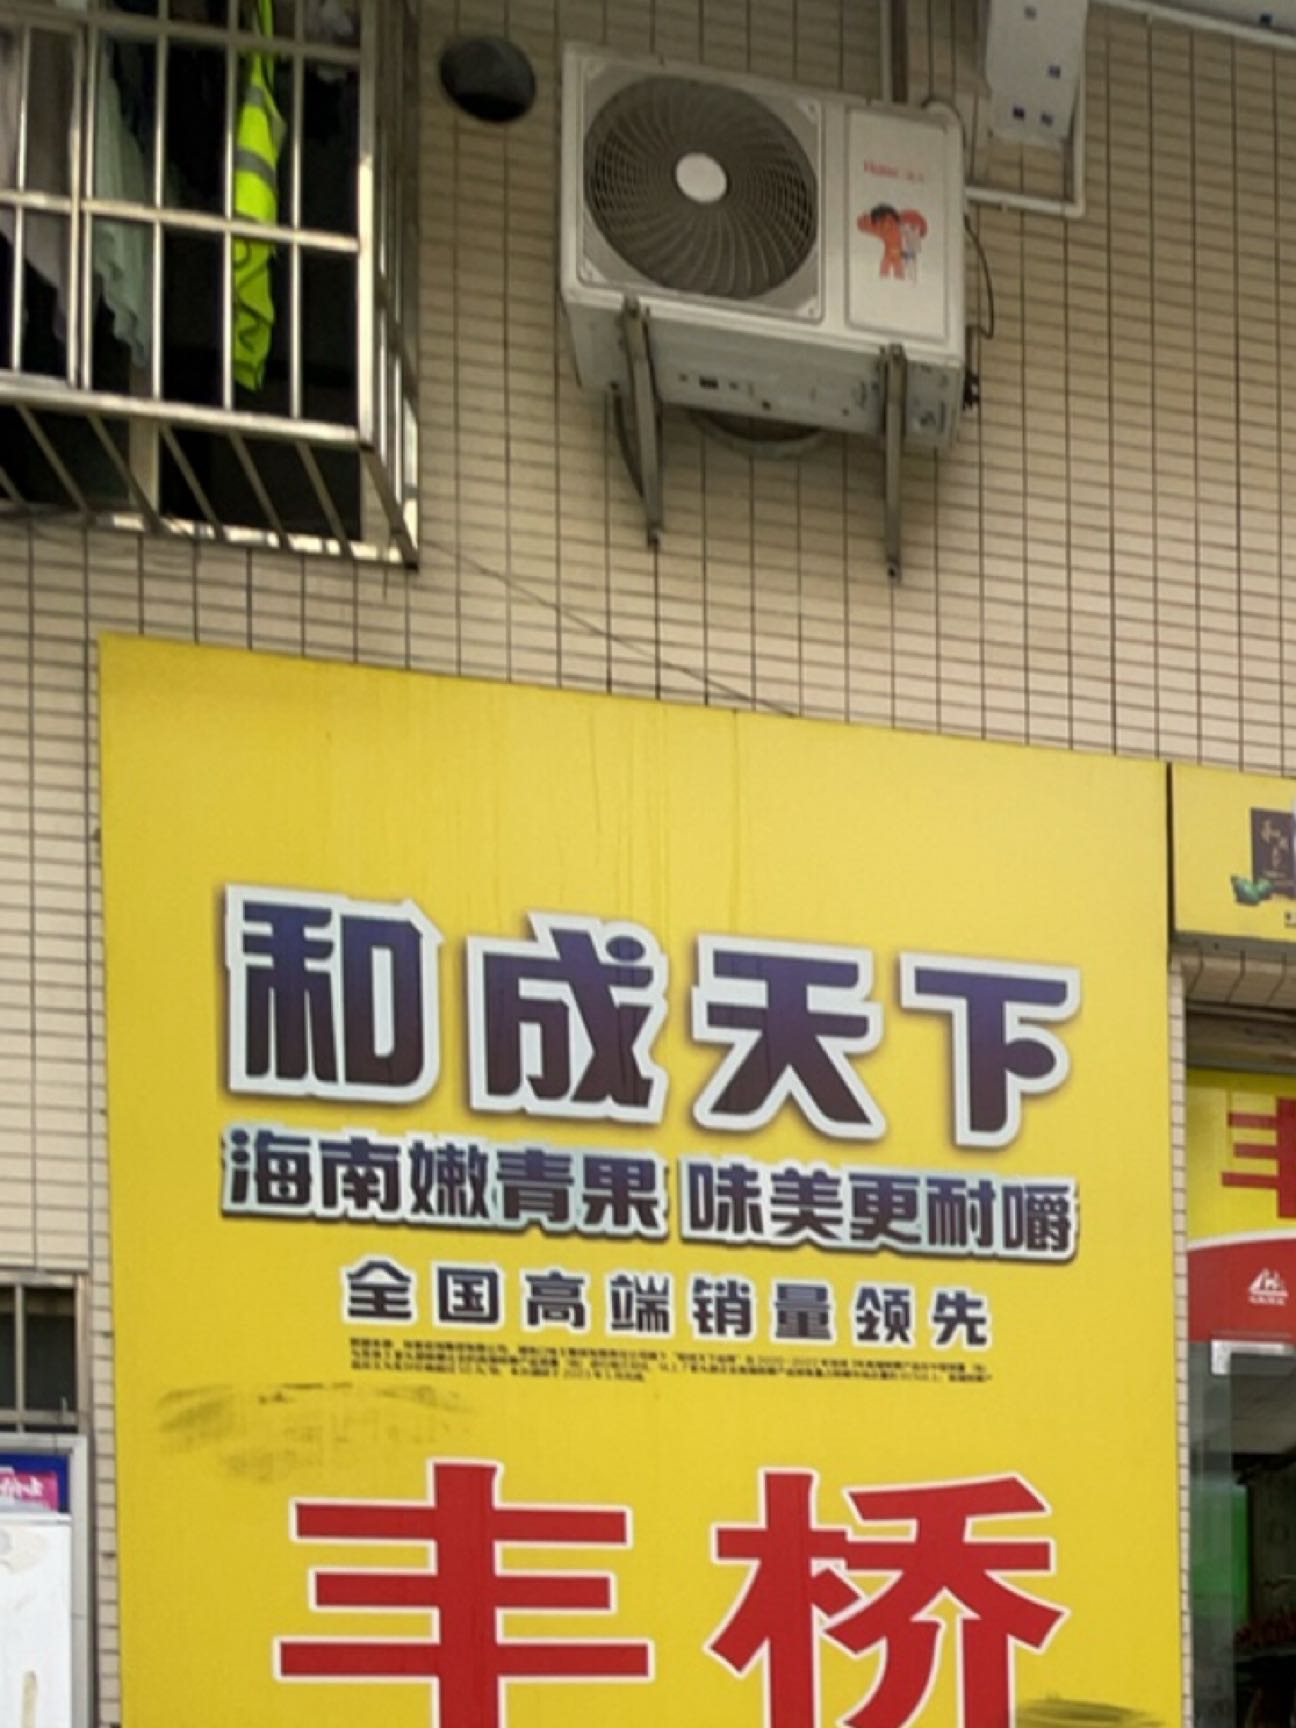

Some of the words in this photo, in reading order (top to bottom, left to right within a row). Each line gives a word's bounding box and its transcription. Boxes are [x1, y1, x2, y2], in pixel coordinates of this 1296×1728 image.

[224, 886, 1076, 1148] 和成天下
[224, 1128, 664, 1234] 海南嫩青果
[686, 1161, 1074, 1256] 味美更耐嚼
[346, 1262, 992, 1346] 全国高端销量领先
